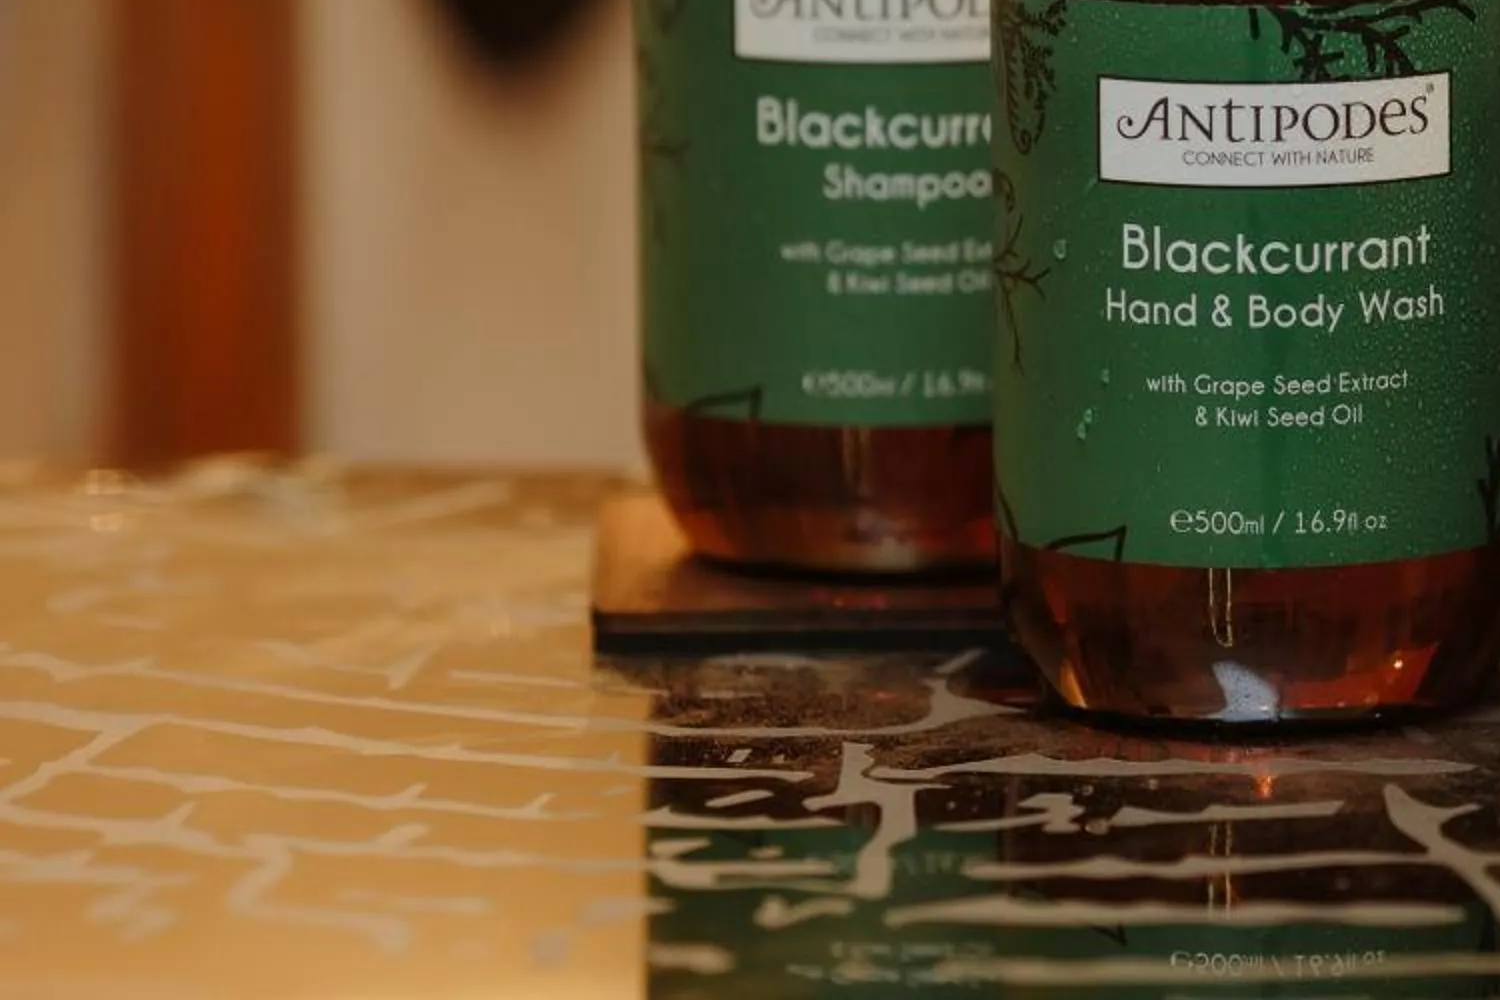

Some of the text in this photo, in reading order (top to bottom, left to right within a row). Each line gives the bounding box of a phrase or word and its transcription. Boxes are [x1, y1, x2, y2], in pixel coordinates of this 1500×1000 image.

[1182, 147, 1375, 167] CONNECT WITH NATURE
[1122, 223, 1431, 275] Blackcurrant
[1106, 284, 1444, 333] Hand & Body Wash
[1146, 369, 1408, 401] with Grape Seed Extract
[1195, 403, 1363, 427] & Kiwi Seed Oil
[1272, 511, 1285, 533] /
[1295, 508, 1358, 535] 16.9fl
[1365, 515, 1388, 530] oz
